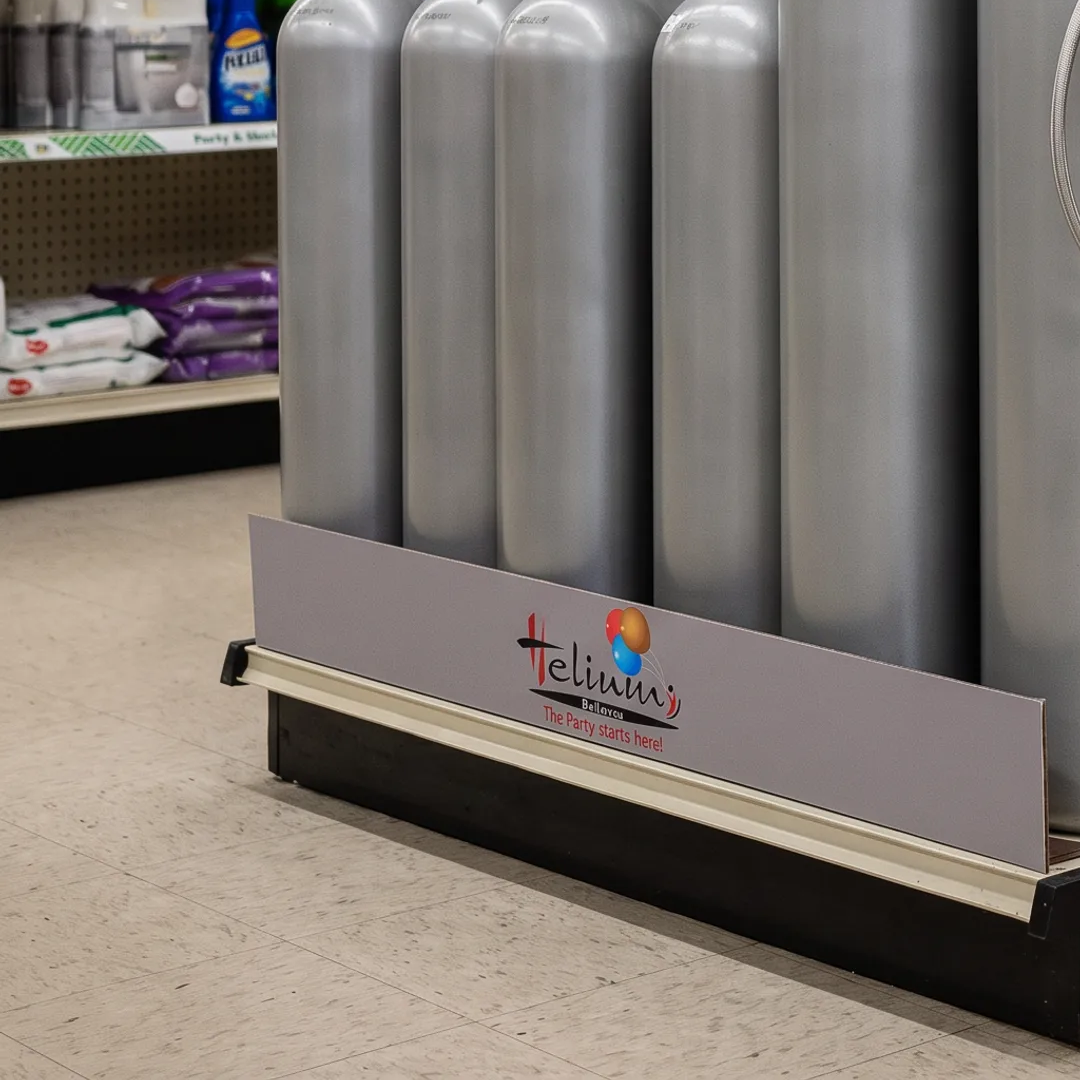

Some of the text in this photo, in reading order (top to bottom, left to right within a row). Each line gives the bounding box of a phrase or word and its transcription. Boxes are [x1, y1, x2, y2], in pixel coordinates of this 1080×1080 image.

[544, 706, 663, 752] The Party starts here!
